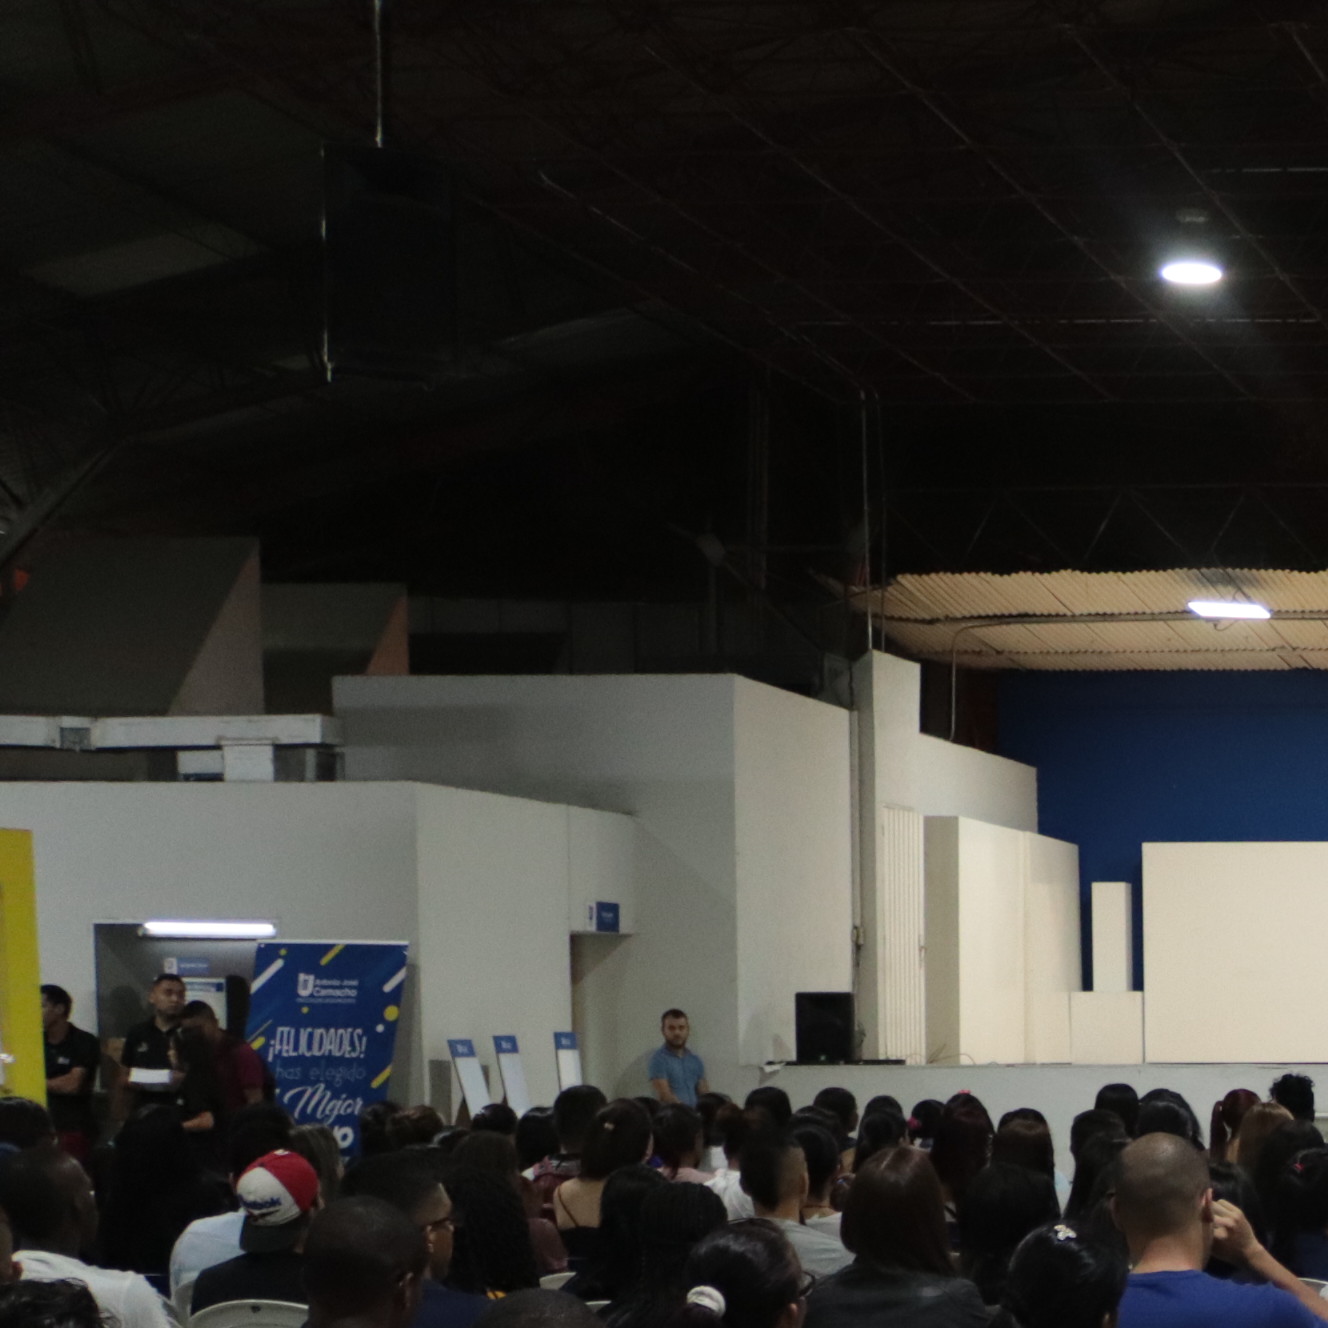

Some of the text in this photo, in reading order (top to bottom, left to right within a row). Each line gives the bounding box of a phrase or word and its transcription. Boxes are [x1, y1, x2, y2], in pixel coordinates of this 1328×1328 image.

[313, 987, 358, 998] Camacho
[267, 1026, 367, 1062] ¡FELICIDADES!
[275, 1059, 367, 1087] has elegido
